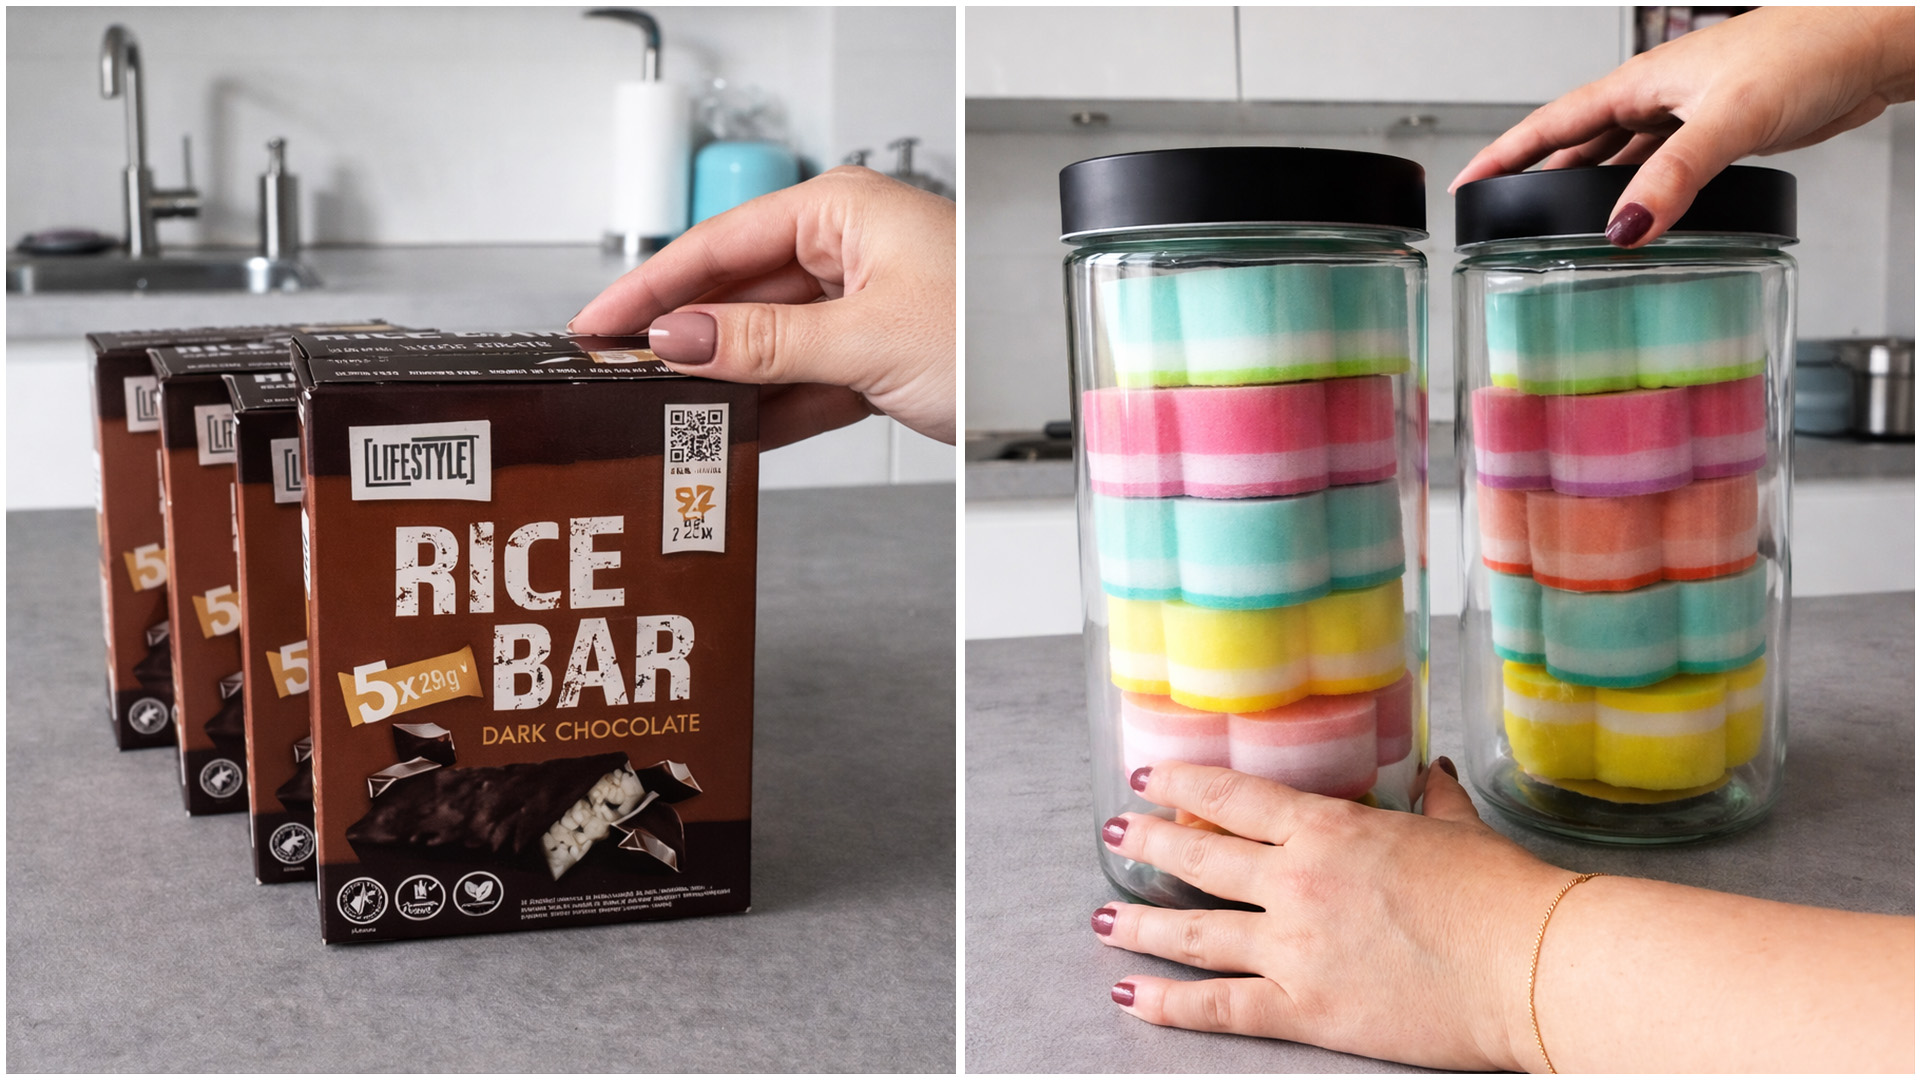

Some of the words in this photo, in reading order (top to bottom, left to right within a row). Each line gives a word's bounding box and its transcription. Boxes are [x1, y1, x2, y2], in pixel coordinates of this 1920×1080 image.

[395, 515, 625, 617] RICE
[493, 614, 695, 711] BAR
[482, 723, 547, 745] DARK
[555, 713, 700, 741] CHOCOLATE
